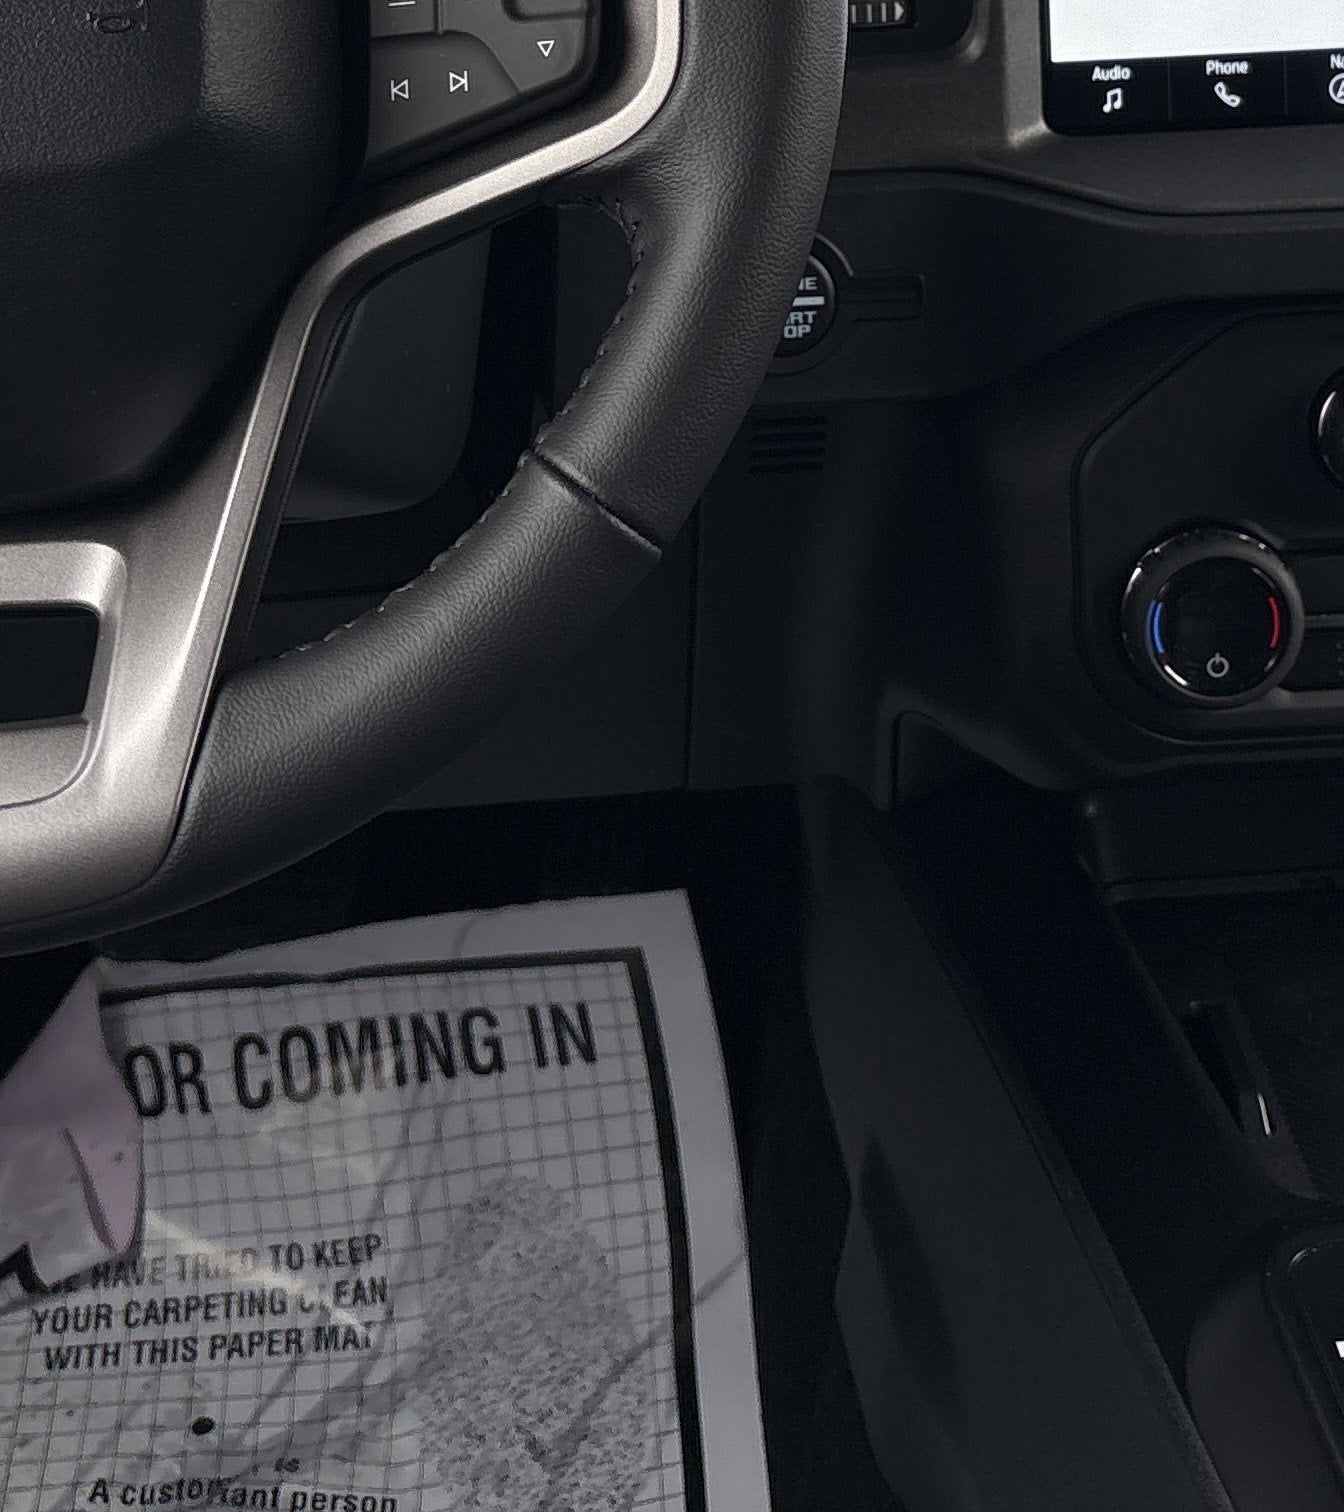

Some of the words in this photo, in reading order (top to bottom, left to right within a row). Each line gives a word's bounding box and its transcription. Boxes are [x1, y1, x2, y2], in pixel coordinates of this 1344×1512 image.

[1091, 65, 1131, 82] Audio
[1206, 59, 1249, 76] Phone
[123, 1040, 211, 1117] OR
[233, 1005, 508, 1110] COMING
[526, 1001, 598, 1069] IN
[269, 1239, 304, 1271] TO
[314, 1233, 382, 1269] KEEP
[31, 1301, 113, 1335] YOUR
[123, 1287, 287, 1329] CARPETING
[43, 1341, 122, 1371] WITH
[131, 1335, 198, 1366] THIS
[209, 1326, 305, 1361] PAPER
[313, 1320, 376, 1353] MAT
[88, 1477, 110, 1504] A
[290, 1488, 397, 1512] person
